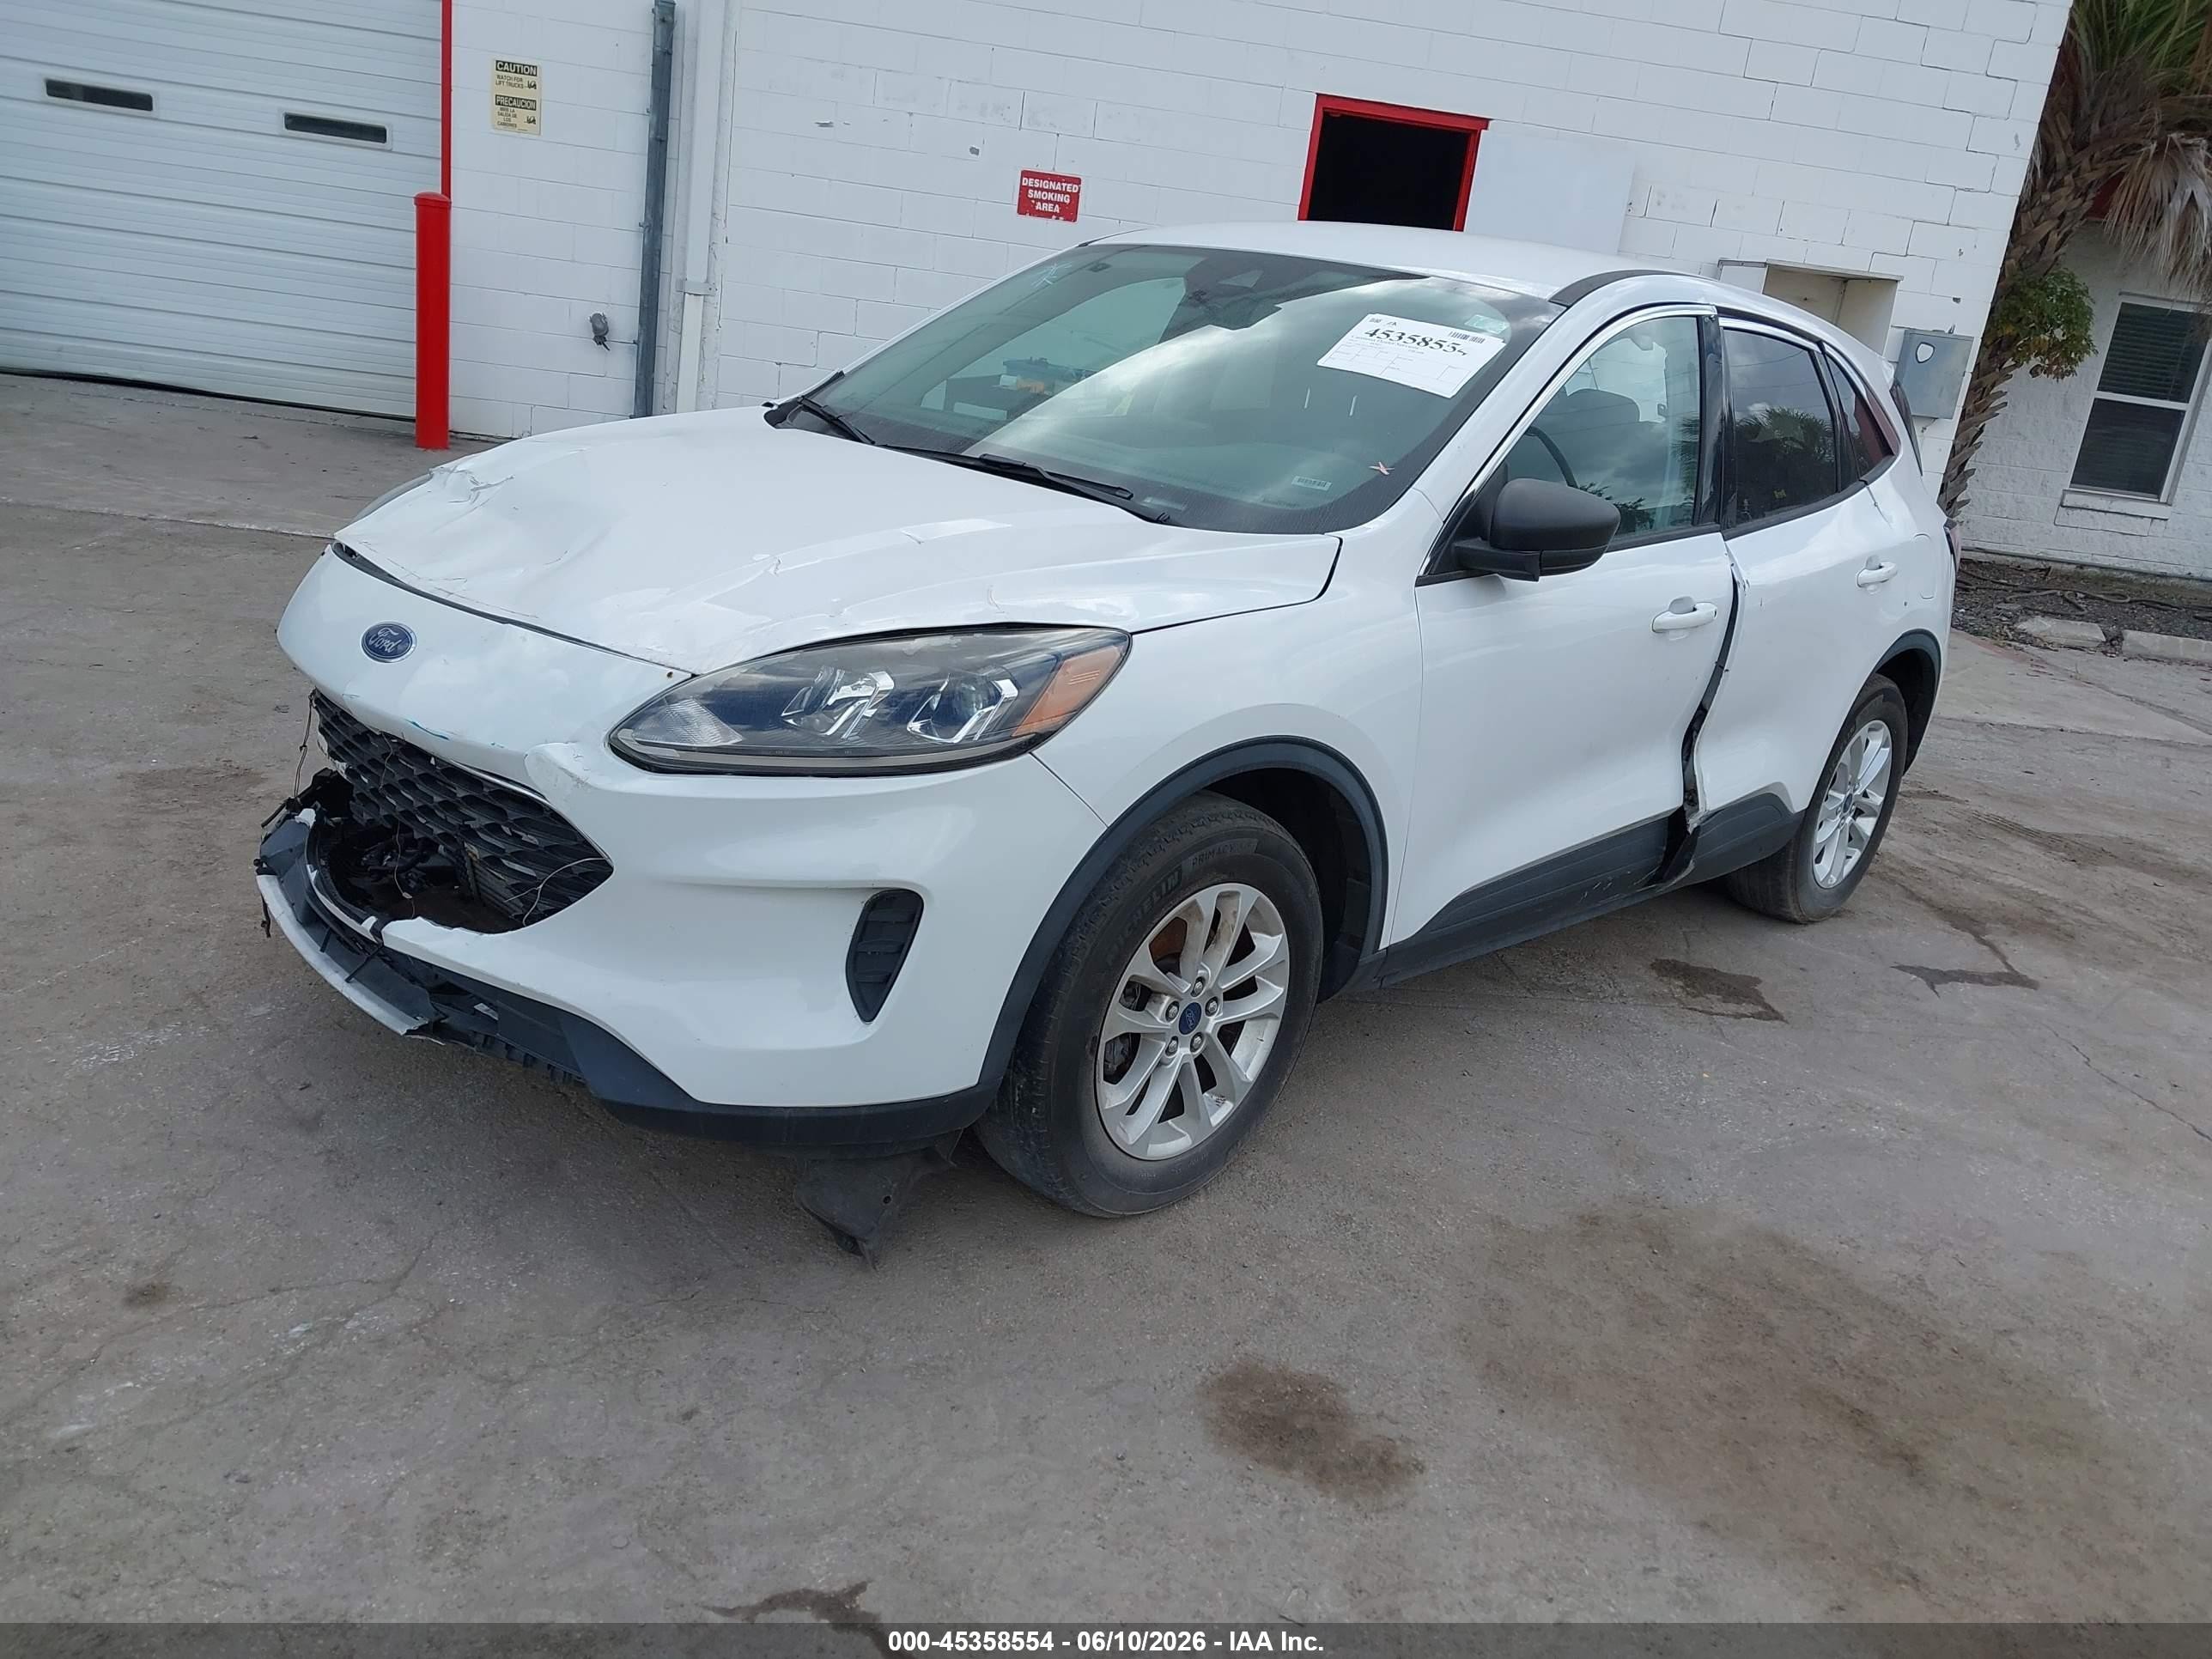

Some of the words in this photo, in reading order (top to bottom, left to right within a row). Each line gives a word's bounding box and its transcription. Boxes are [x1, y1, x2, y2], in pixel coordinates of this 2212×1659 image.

[497, 61, 537, 76] CAUTION
[496, 96, 536, 110] PRECAUCION
[1022, 177, 1079, 193] DESIGNATED
[1027, 189, 1071, 204] SMOKING
[1035, 201, 1060, 214] AREA
[368, 627, 403, 653] Ford
